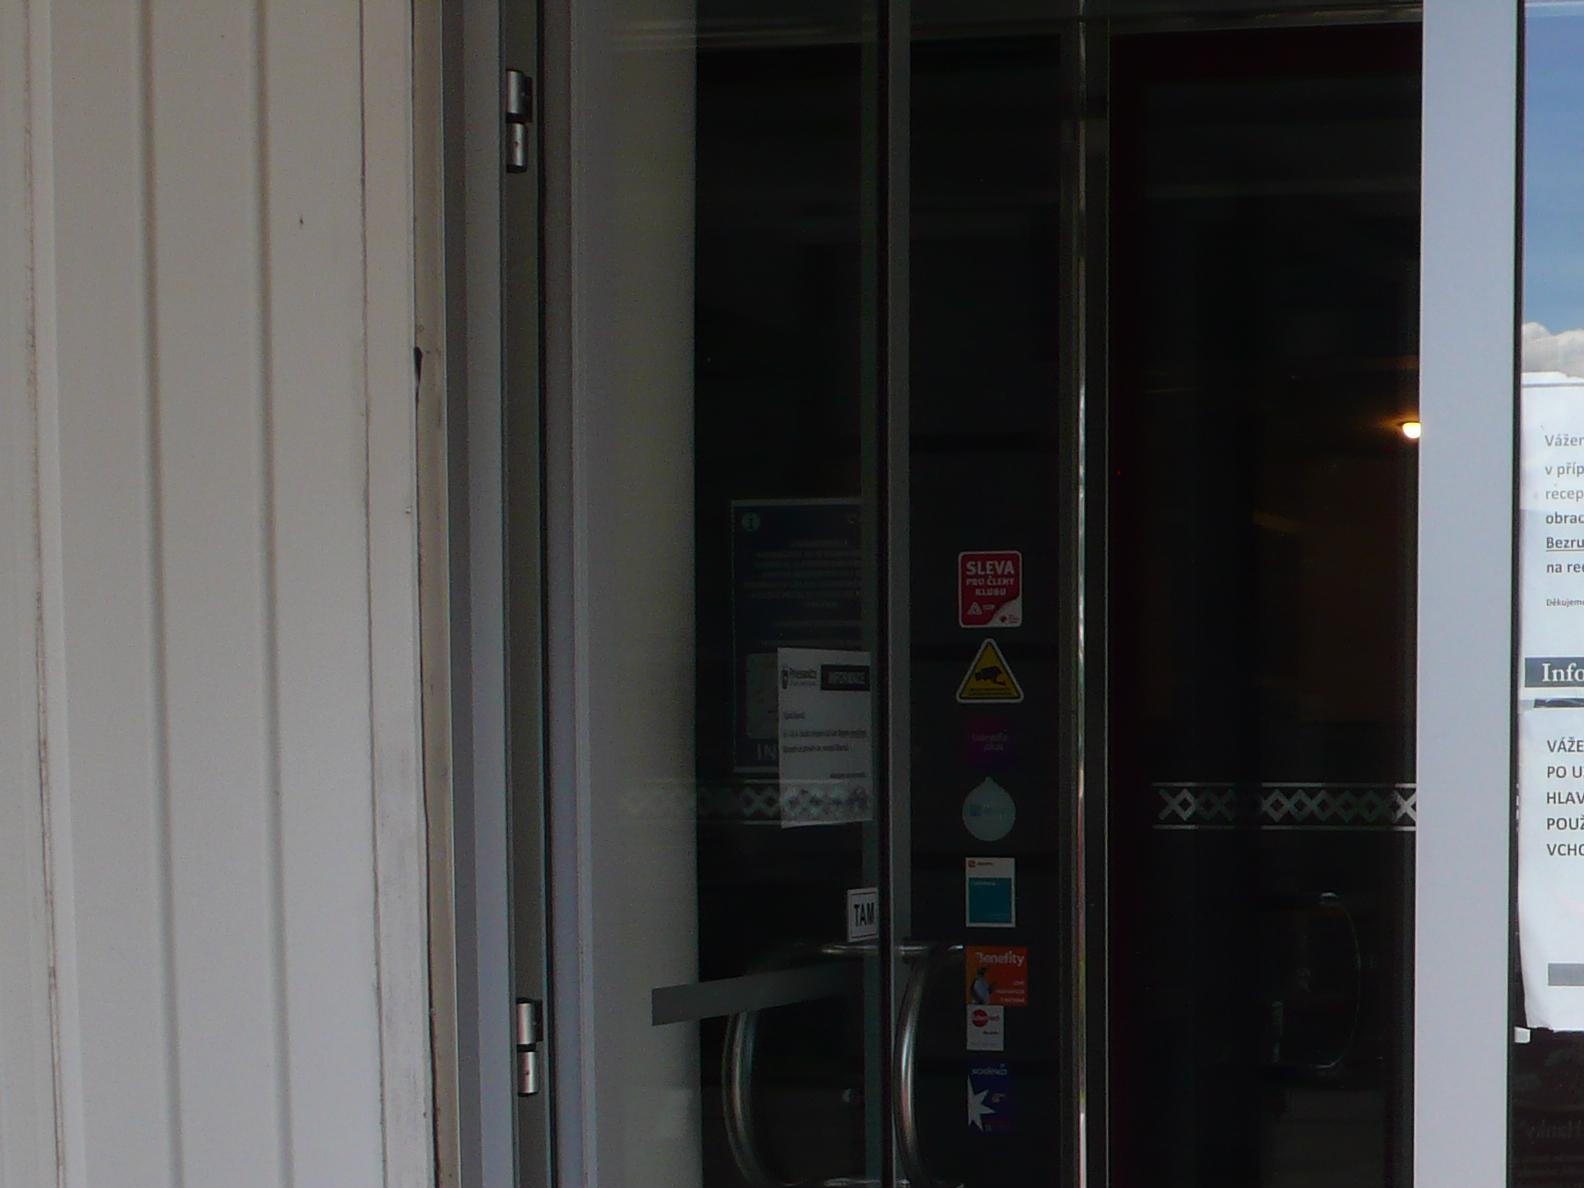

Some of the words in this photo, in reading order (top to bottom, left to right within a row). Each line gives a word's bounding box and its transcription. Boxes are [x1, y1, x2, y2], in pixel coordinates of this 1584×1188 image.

[1545, 466, 1552, 475] v
[966, 560, 1014, 575] SLEVA
[1547, 563, 1562, 573] na
[1547, 766, 1567, 779] PO
[854, 903, 874, 927] TAM
